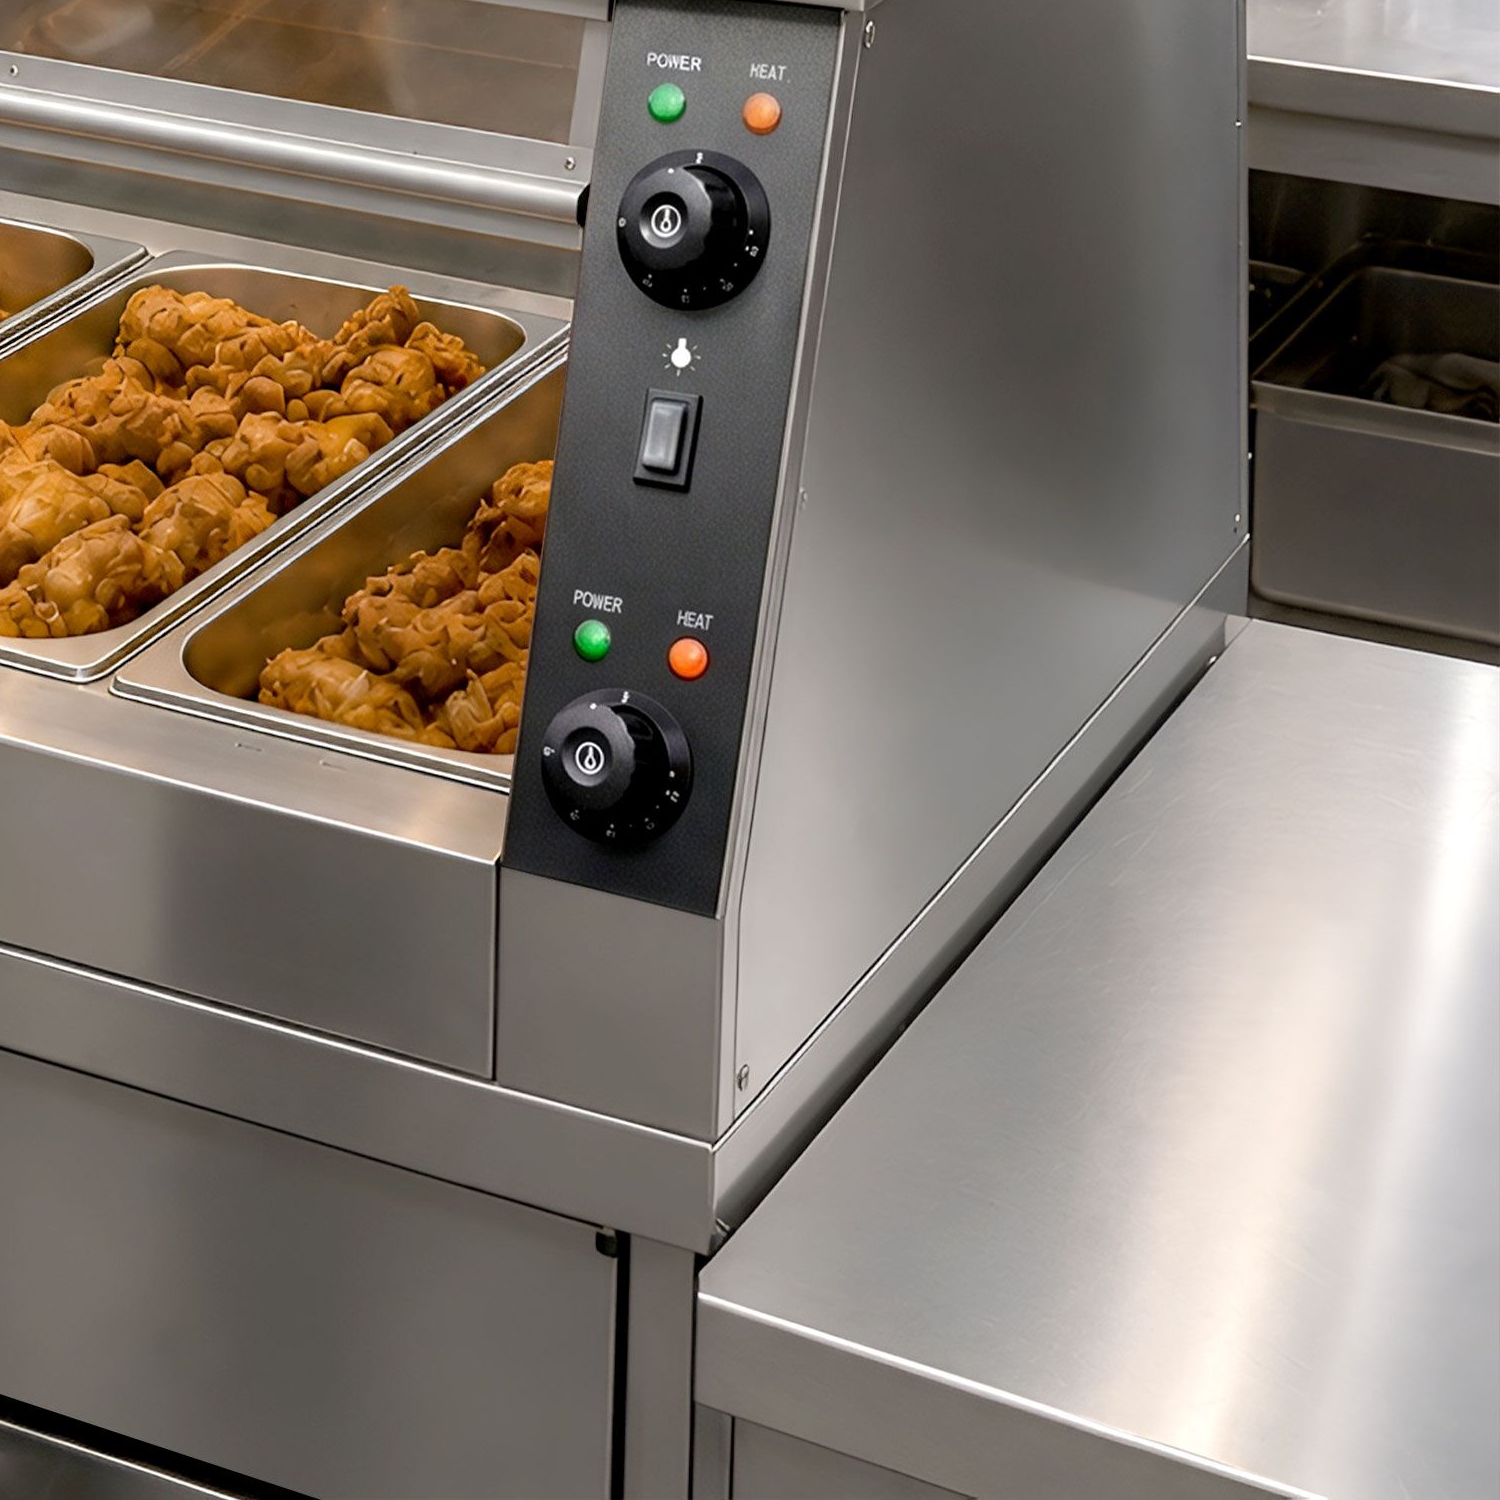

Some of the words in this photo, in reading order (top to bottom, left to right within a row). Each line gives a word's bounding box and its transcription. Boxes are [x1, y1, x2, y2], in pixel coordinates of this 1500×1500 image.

[647, 52, 702, 71] POWER
[573, 589, 623, 614] POWER
[676, 610, 714, 631] HEAT
